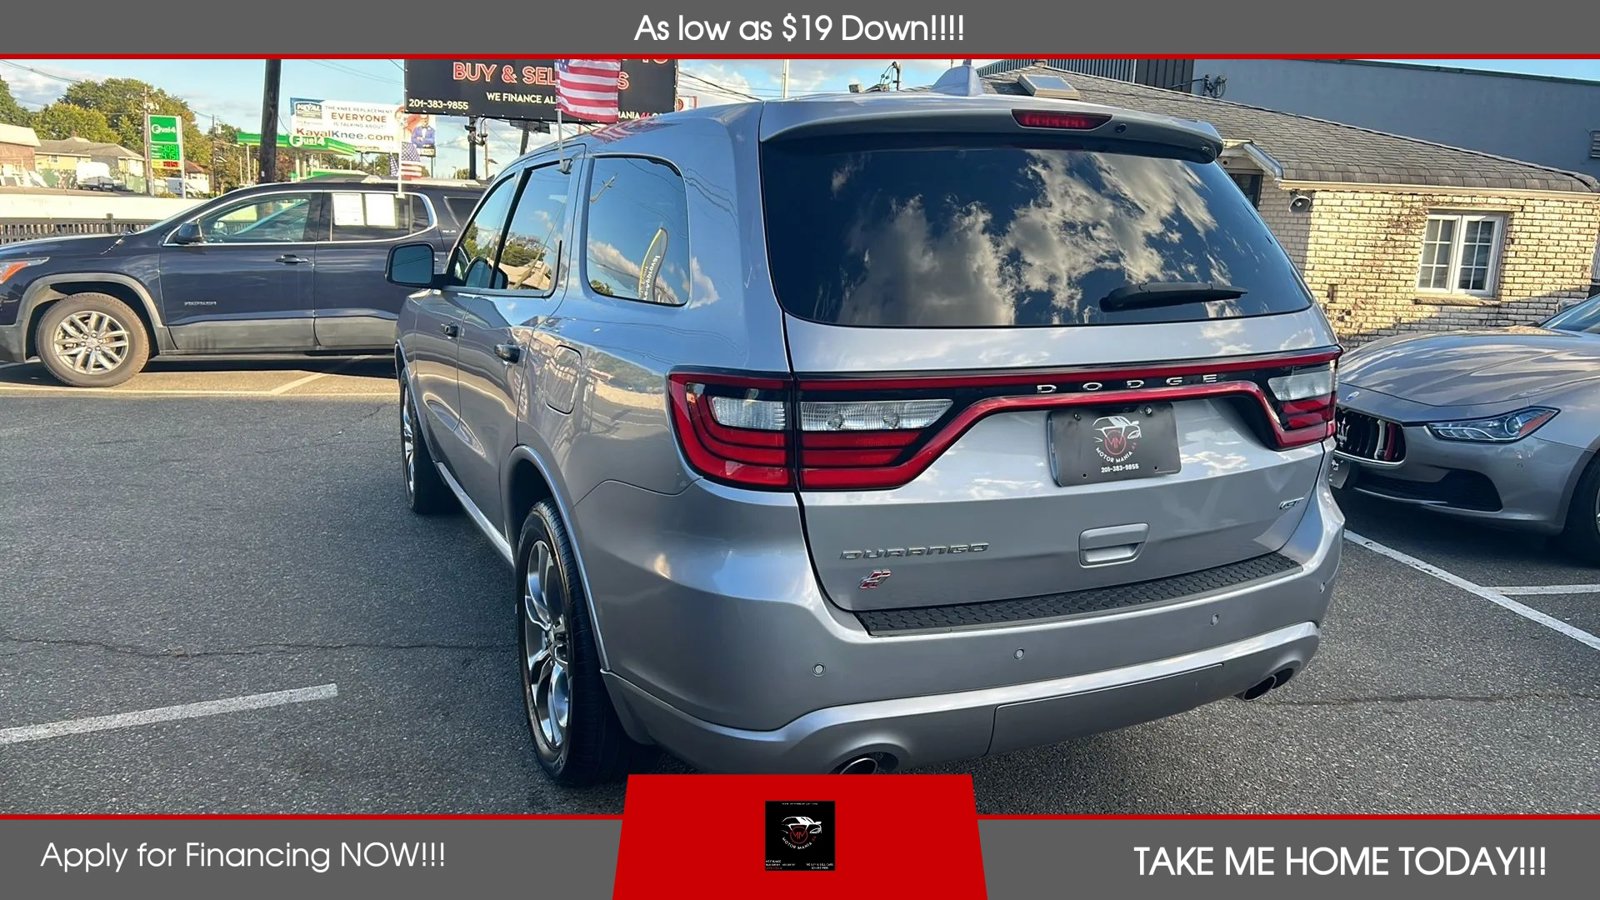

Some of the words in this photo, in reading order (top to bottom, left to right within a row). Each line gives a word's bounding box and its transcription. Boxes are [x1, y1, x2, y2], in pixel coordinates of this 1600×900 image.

[453, 61, 497, 82] BUY
[501, 65, 518, 83] &
[408, 99, 469, 111] 201-383-9855
[486, 92, 501, 102] WE
[502, 93, 542, 104] FINANCE
[331, 112, 387, 123] EVERYONE
[151, 124, 176, 134] Fuel4
[296, 127, 394, 142] KayalKnee.com
[1036, 373, 1219, 394] DODGE
[1095, 447, 1115, 463] MOTOR
[1115, 450, 1133, 463] MANIA
[839, 542, 990, 560] DURANGO
